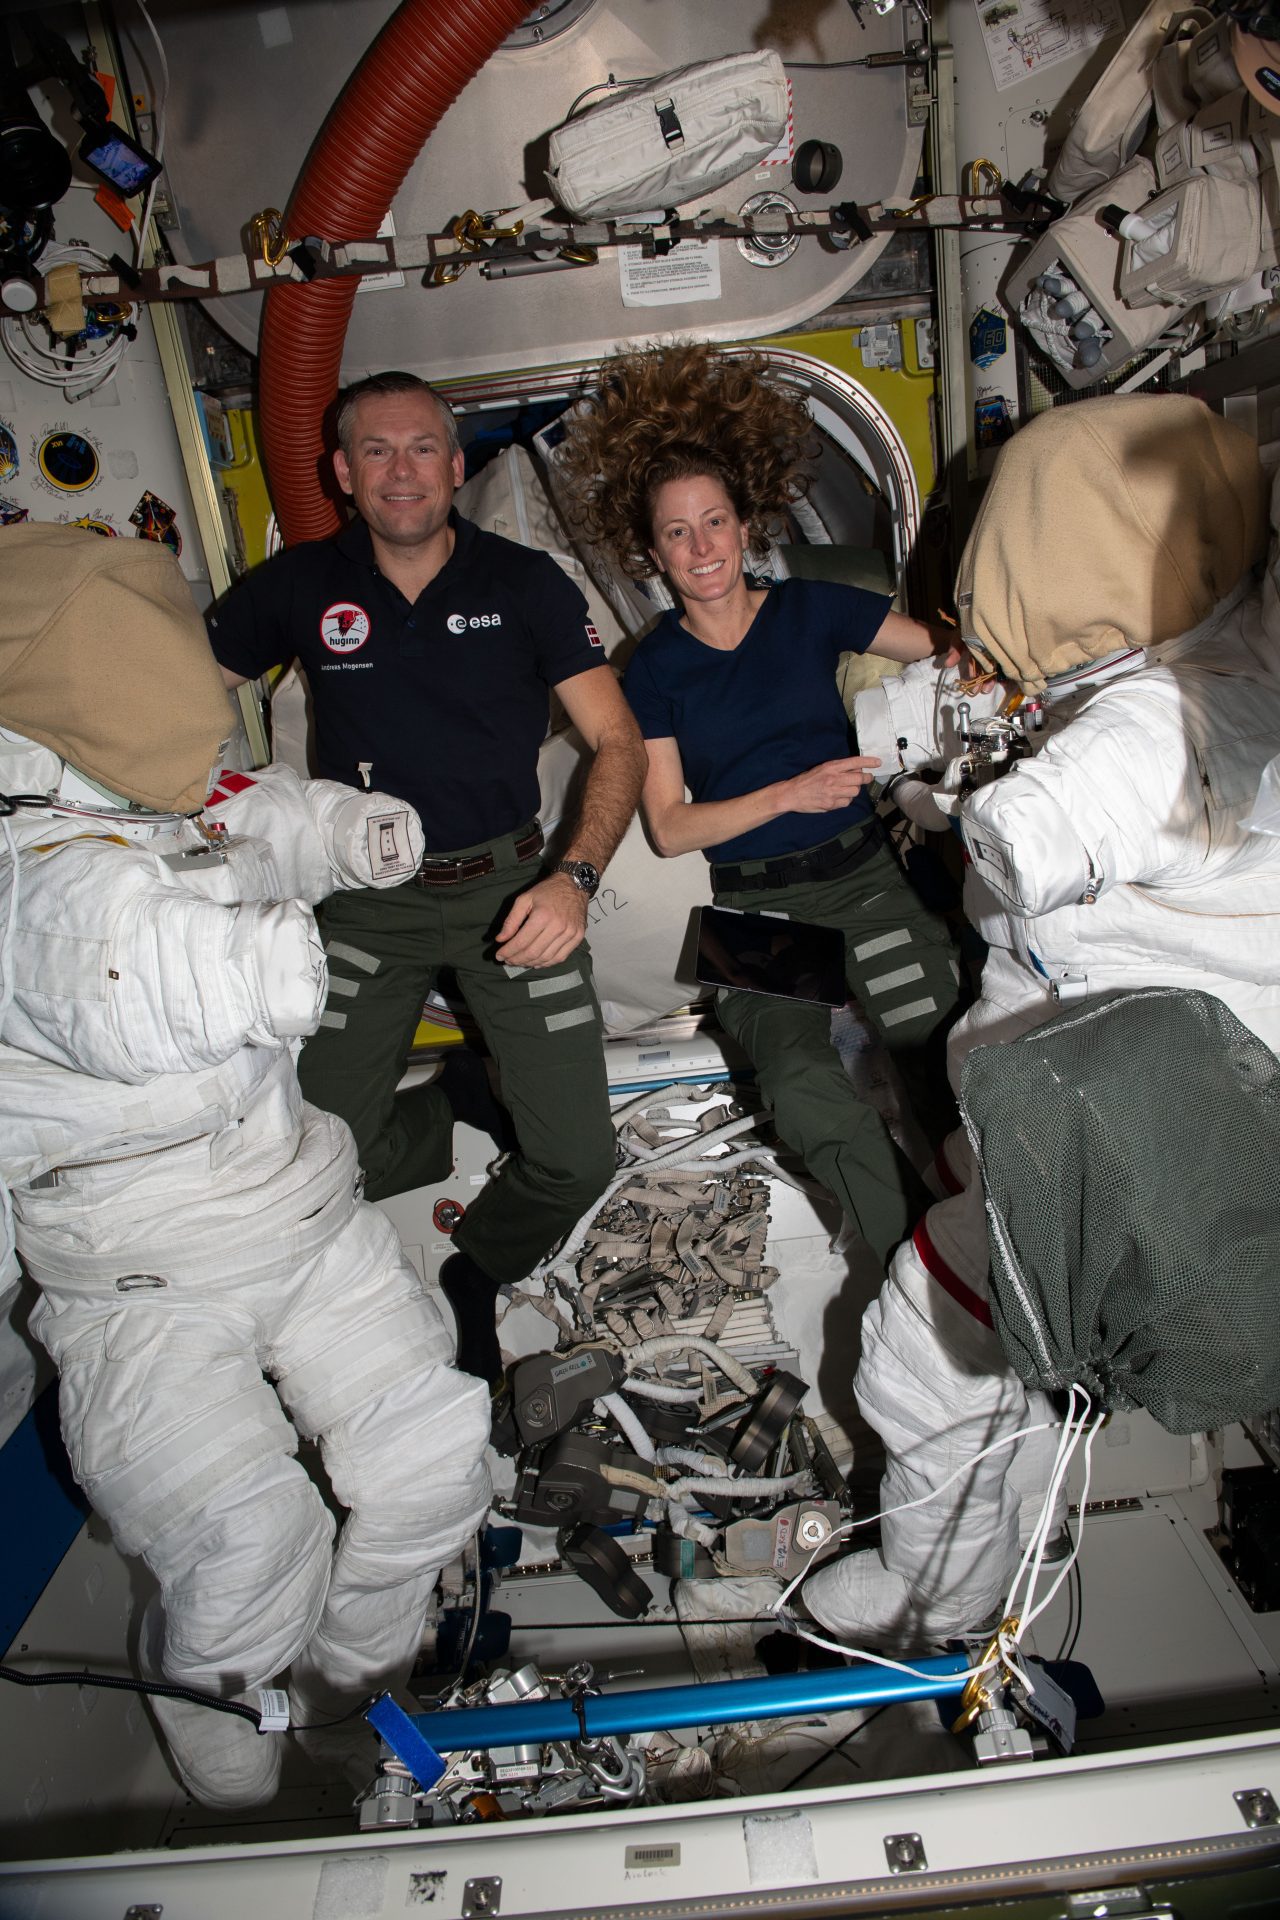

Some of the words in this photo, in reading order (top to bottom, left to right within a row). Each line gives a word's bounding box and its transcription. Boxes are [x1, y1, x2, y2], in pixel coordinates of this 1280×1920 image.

[983, 328, 1006, 348] 60
[51, 440, 63, 449] XVI
[469, 613, 502, 629] esa
[329, 637, 360, 647] huginn
[342, 662, 374, 671] Mogensen
